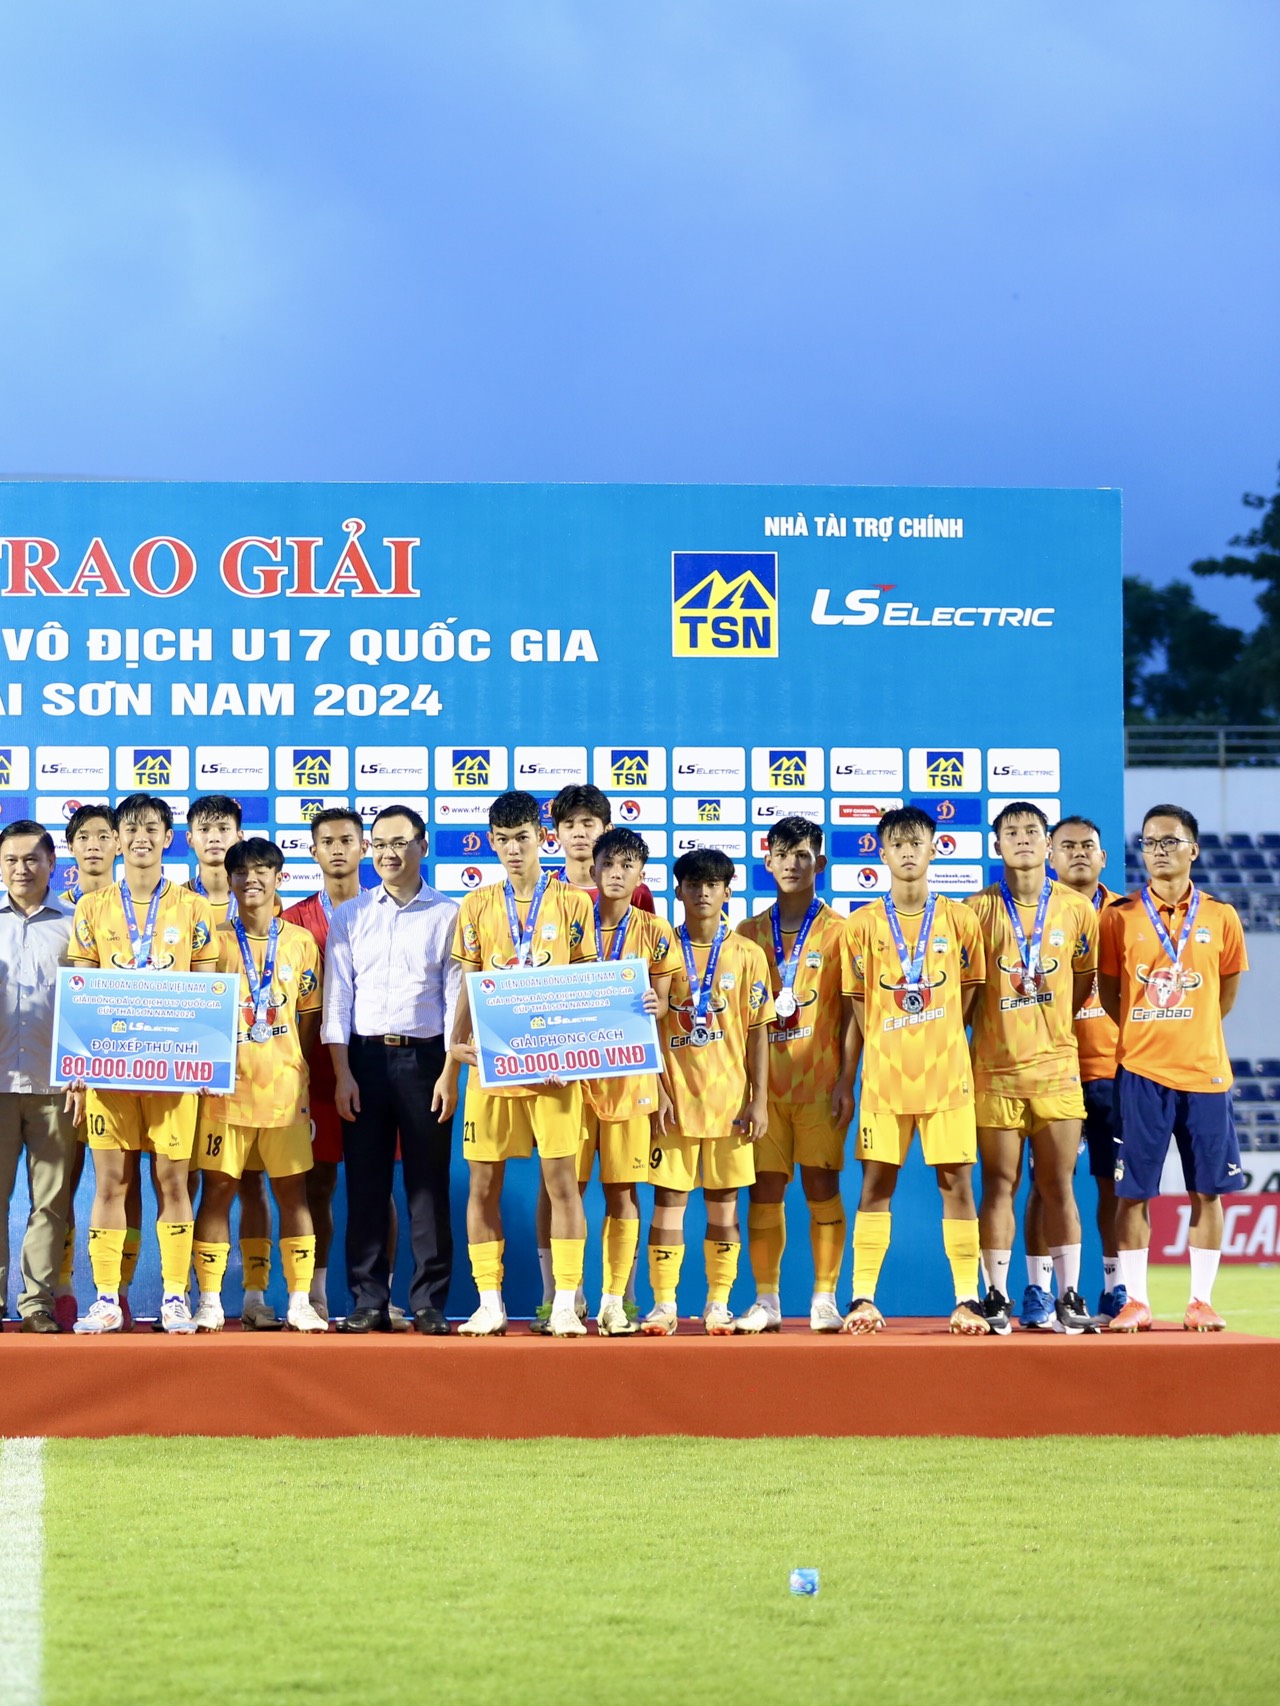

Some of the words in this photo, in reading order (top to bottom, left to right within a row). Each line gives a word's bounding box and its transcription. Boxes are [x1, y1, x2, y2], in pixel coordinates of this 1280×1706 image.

[764, 512, 810, 538] NHÀ
[814, 513, 846, 538] TÀI
[852, 514, 894, 541] TRỢ
[898, 514, 964, 539] CHÍNH
[220, 518, 420, 598] GIẢI
[811, 588, 884, 627] LS
[680, 616, 771, 649] TSN
[2, 621, 68, 661] VÔ
[87, 628, 213, 668] ĐỊCH
[232, 628, 330, 662] U17
[349, 616, 491, 663] QUỐC
[510, 629, 599, 662] GIA
[42, 678, 154, 716] SƠN
[171, 684, 296, 716] NAM
[313, 683, 444, 717] 2024
[41, 763, 58, 773] LS
[201, 763, 218, 773] LS
[361, 763, 378, 773] LS
[520, 764, 538, 774] LS
[678, 764, 696, 774] LS
[835, 765, 852, 775] LS
[993, 766, 1010, 776] LS
[136, 773, 169, 785] TSN
[296, 773, 328, 786] TSN
[455, 773, 488, 786] TSN
[613, 774, 646, 786] TSN
[771, 774, 804, 786] TSN
[929, 775, 962, 788] TSN
[699, 813, 720, 822] TSN
[757, 807, 775, 816] LS
[597, 972, 616, 982] NAM
[186, 982, 206, 993] NAM
[154, 1009, 175, 1017] NAM
[1132, 1008, 1192, 1020] Carabao
[128, 1022, 144, 1031] LS
[884, 1008, 944, 1032] Carabao
[510, 1034, 538, 1049] GIẢI
[539, 1032, 586, 1046] PHONG
[588, 1028, 624, 1042] CÁCH
[770, 1026, 812, 1042] rabao
[92, 1037, 115, 1054] ĐỘI
[118, 1037, 143, 1052] XẾP
[144, 1040, 173, 1053] THỨ
[494, 1049, 601, 1076] 30.000.000
[605, 1044, 646, 1066] VNĐ
[62, 1056, 168, 1080] 80.000.000
[174, 1060, 214, 1082] VNĐ
[90, 1113, 106, 1136] 10
[464, 1121, 476, 1144] 21
[206, 1134, 222, 1157] 18
[650, 1148, 662, 1169] 9
